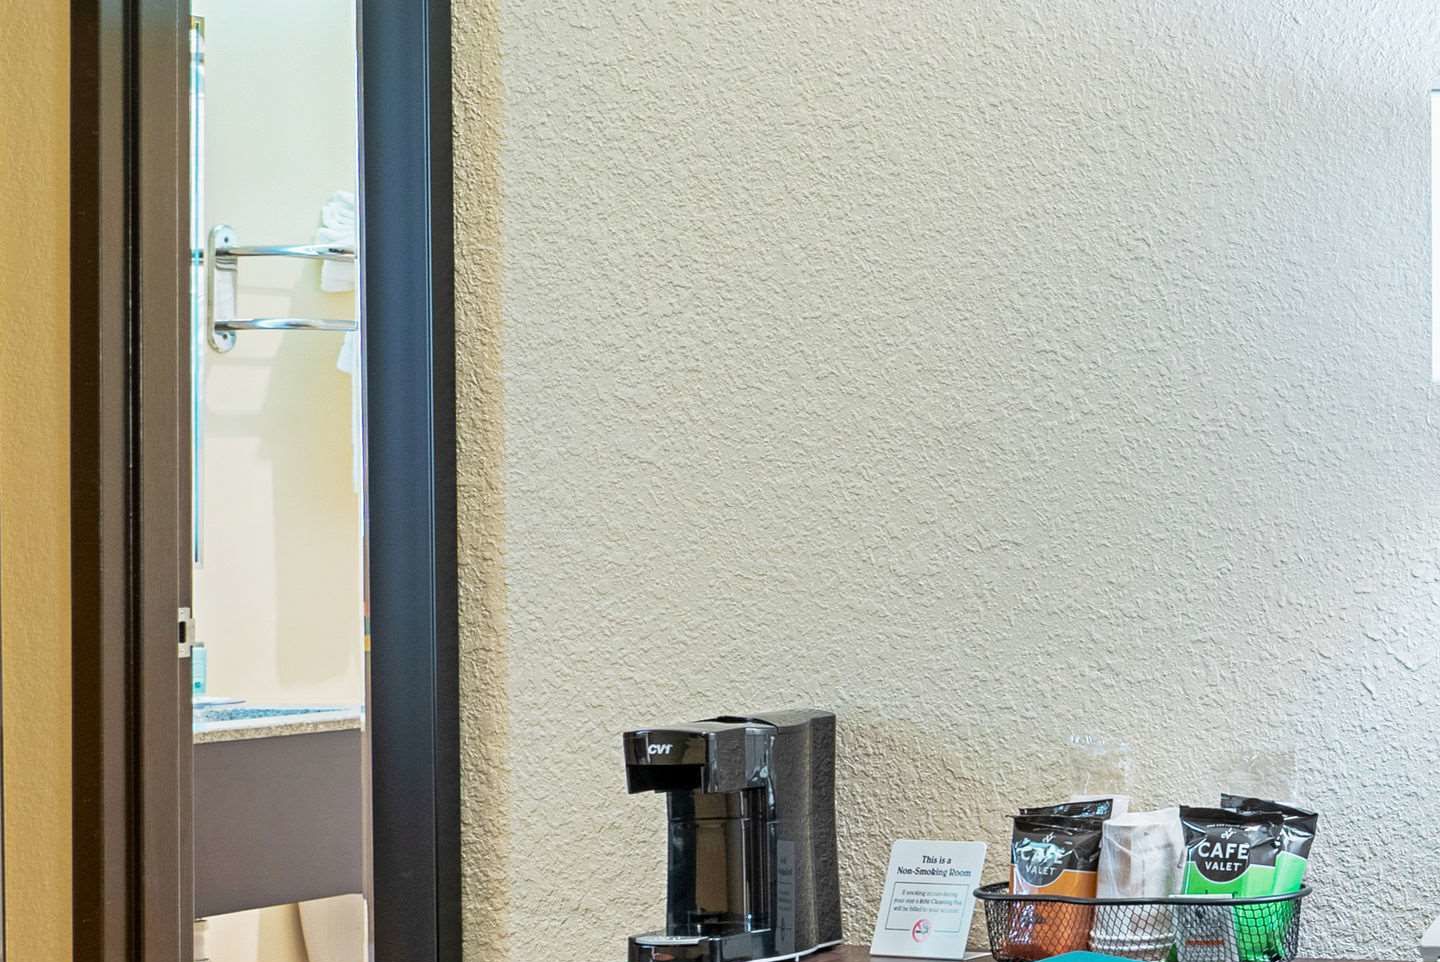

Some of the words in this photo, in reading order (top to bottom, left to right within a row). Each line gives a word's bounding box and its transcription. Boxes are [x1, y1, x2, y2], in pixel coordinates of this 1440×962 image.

[1198, 842, 1250, 860] CAFE
[922, 855, 937, 864] This
[939, 856, 946, 864] is
[897, 866, 948, 878] Non-Smoking
[949, 869, 972, 877] Room
[1025, 864, 1056, 876] VALET
[1204, 861, 1241, 872] VALET
